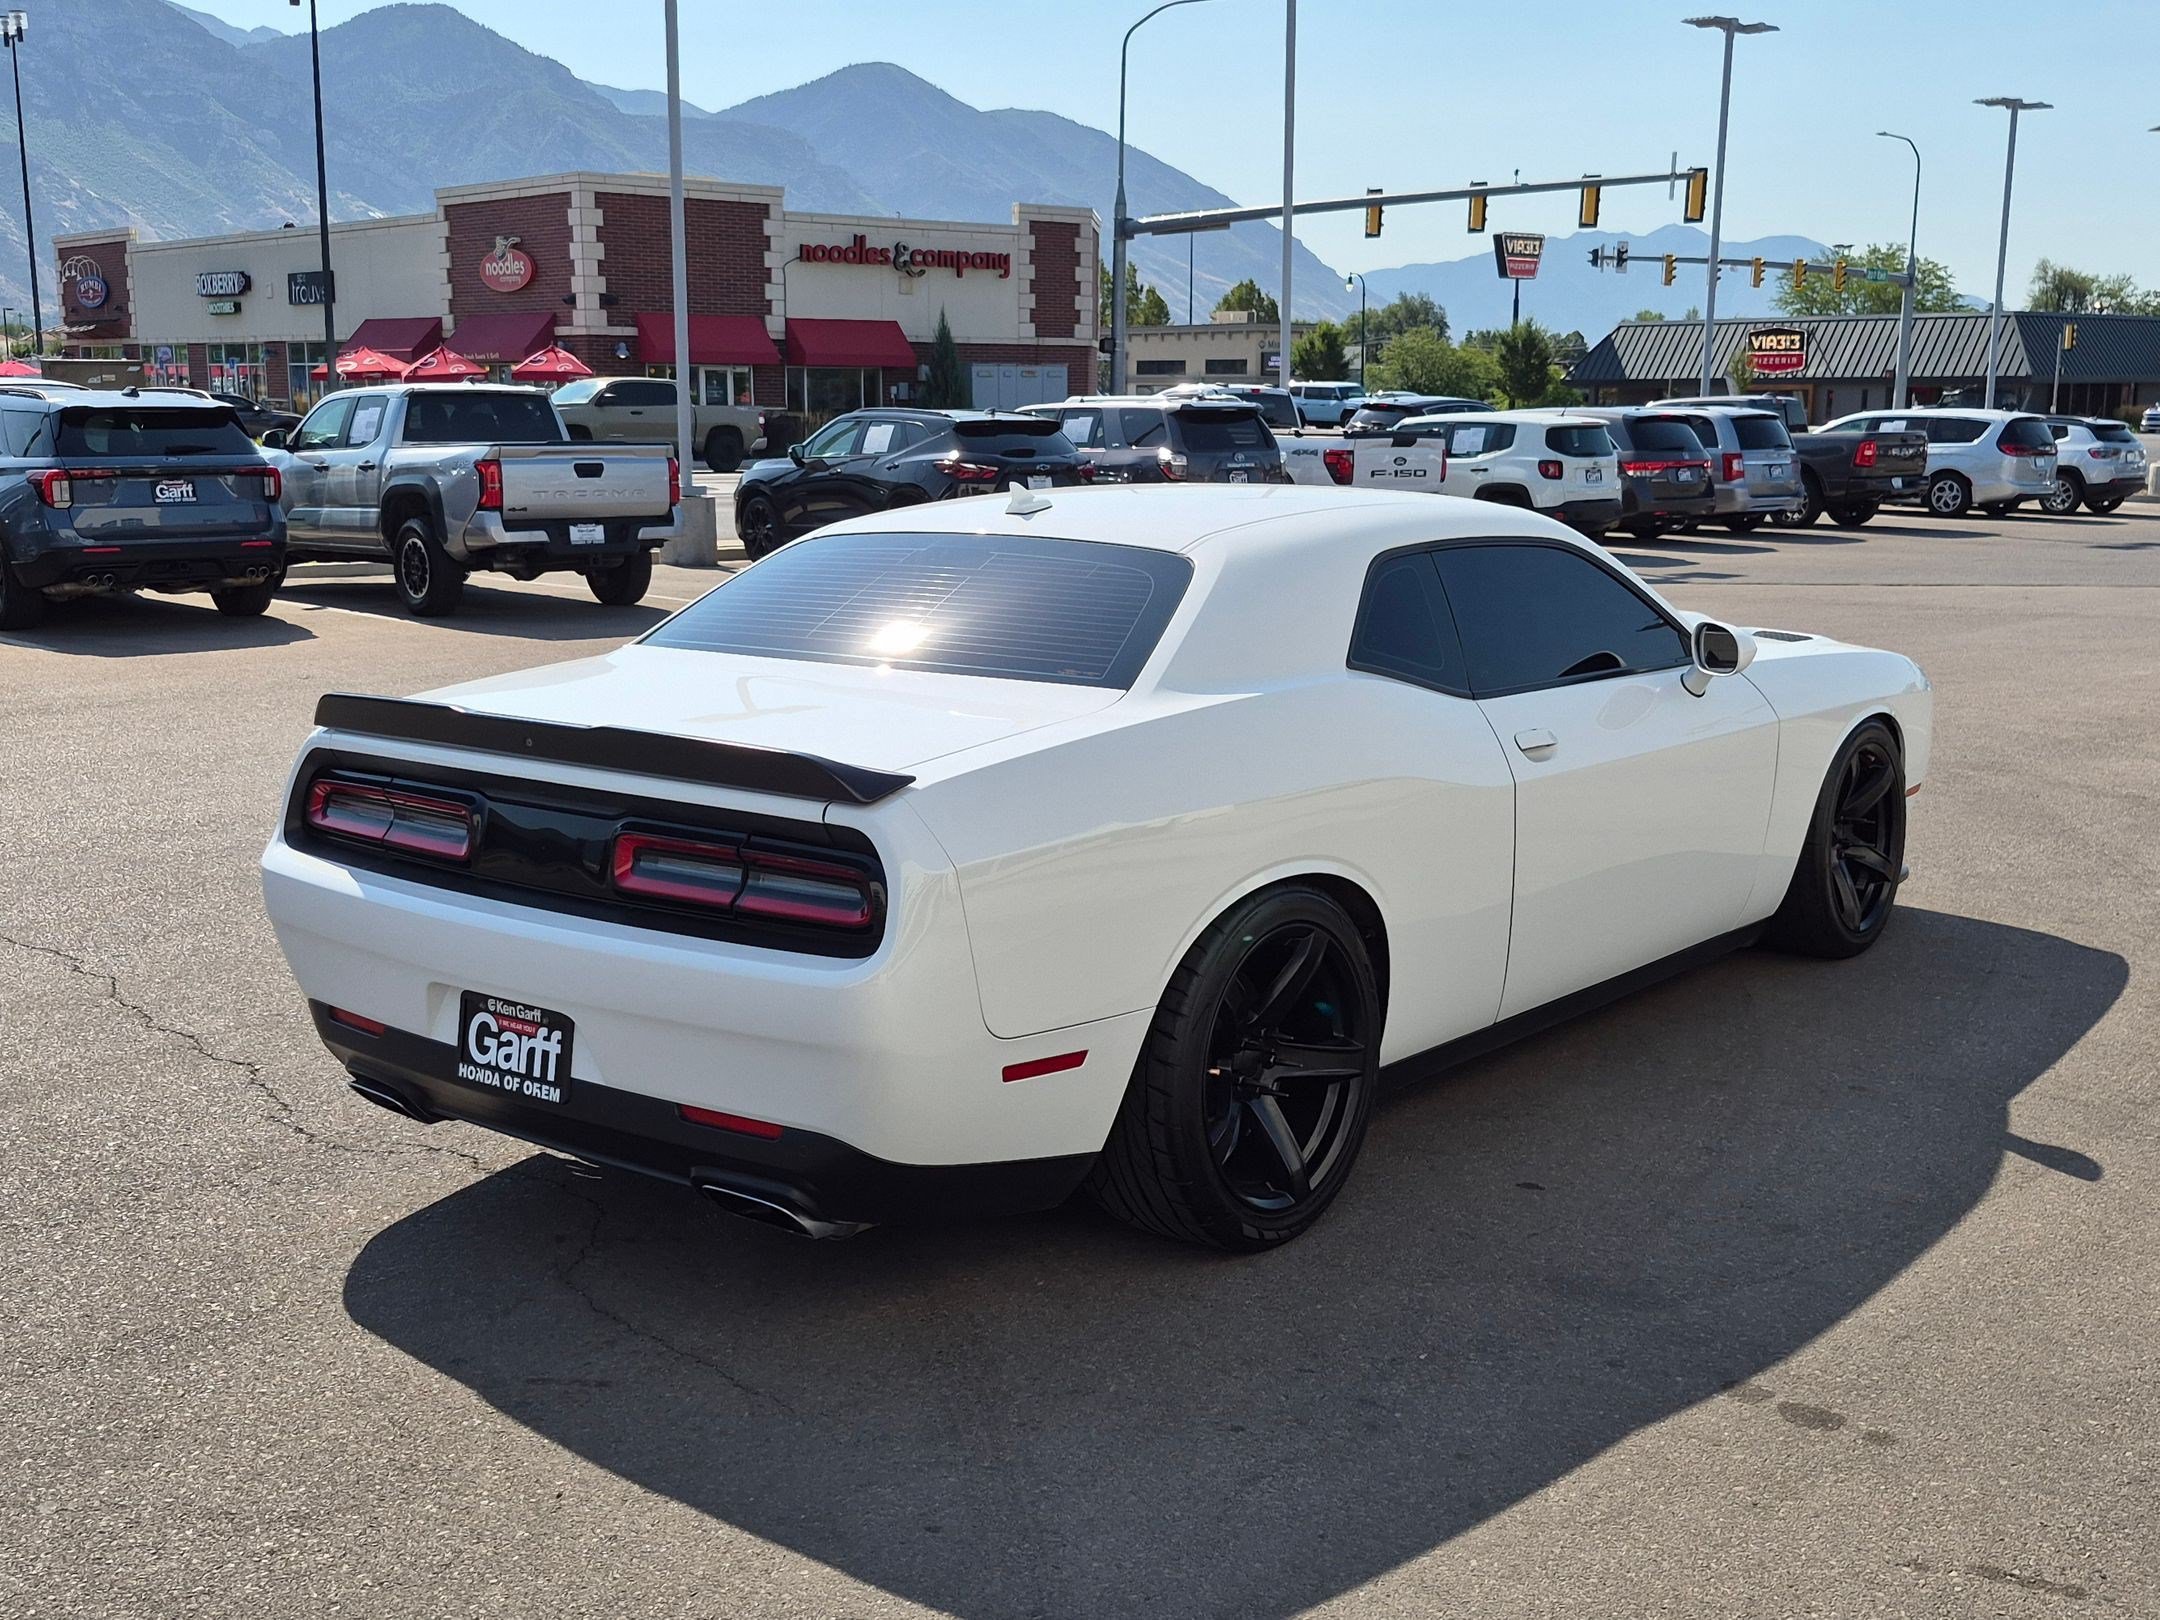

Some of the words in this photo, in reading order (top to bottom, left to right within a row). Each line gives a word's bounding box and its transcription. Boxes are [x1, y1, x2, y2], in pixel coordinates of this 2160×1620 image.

[485, 252, 525, 276] noodles
[800, 234, 891, 265] noodles
[910, 248, 1010, 279] company
[195, 272, 239, 296] ROXBERRY
[1750, 334, 1801, 350] VIA313
[1370, 469, 1427, 478] F-150
[155, 483, 193, 498] Garff
[496, 1000, 515, 1017] Ken
[516, 1005, 541, 1023] Garff
[468, 1011, 562, 1082] Garff
[458, 1062, 500, 1087] HONDA
[503, 1075, 520, 1092] OF
[523, 1080, 560, 1103] OREM
